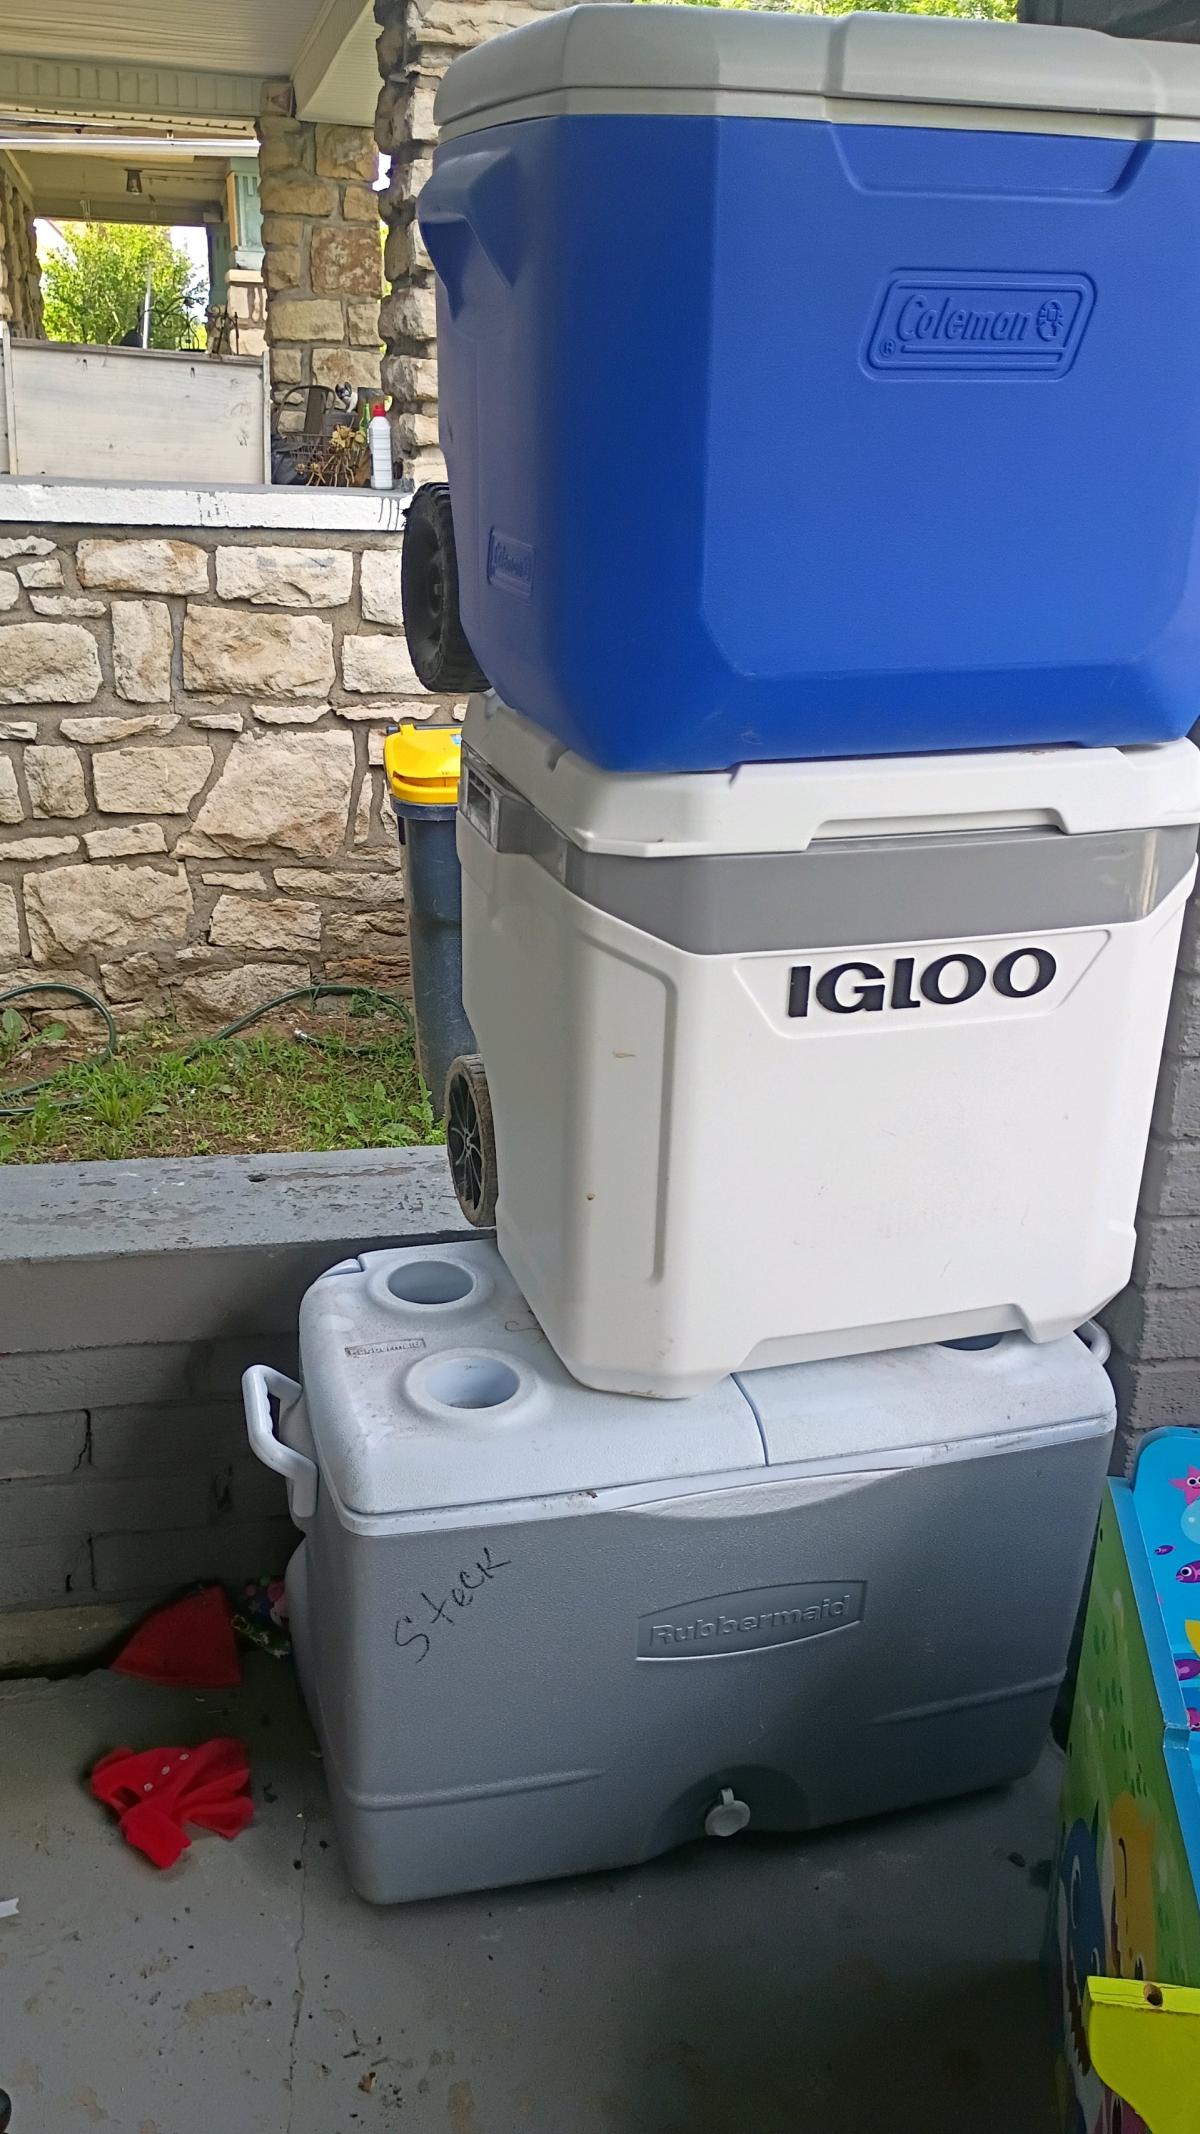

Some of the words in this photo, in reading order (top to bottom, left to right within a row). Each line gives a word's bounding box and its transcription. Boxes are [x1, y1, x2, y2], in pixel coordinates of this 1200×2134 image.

[896, 294, 1033, 342] Coleman
[788, 947, 1057, 1018] IGLOO
[650, 1595, 851, 1646] Rubbermaid
